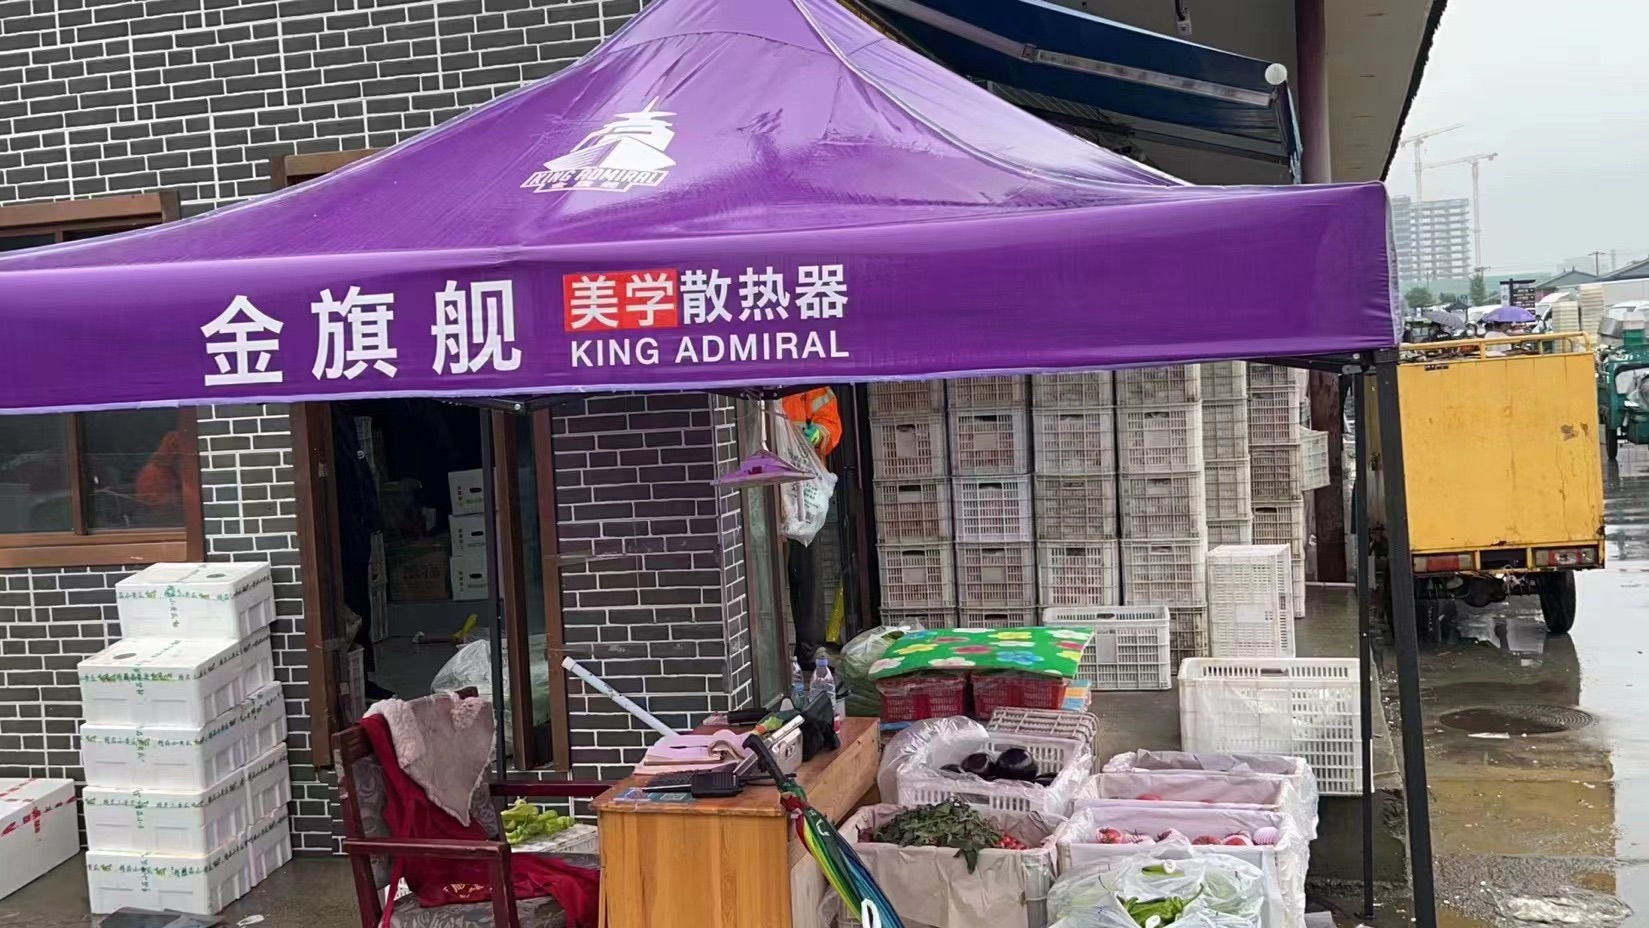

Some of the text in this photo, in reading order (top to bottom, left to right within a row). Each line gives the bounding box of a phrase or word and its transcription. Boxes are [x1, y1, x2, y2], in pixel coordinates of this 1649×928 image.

[530, 168, 660, 185] KING ADMIRAL
[569, 264, 849, 329] 美学散热器
[200, 279, 522, 386] 金旗舰
[570, 330, 850, 368] KING ADMIRAL
